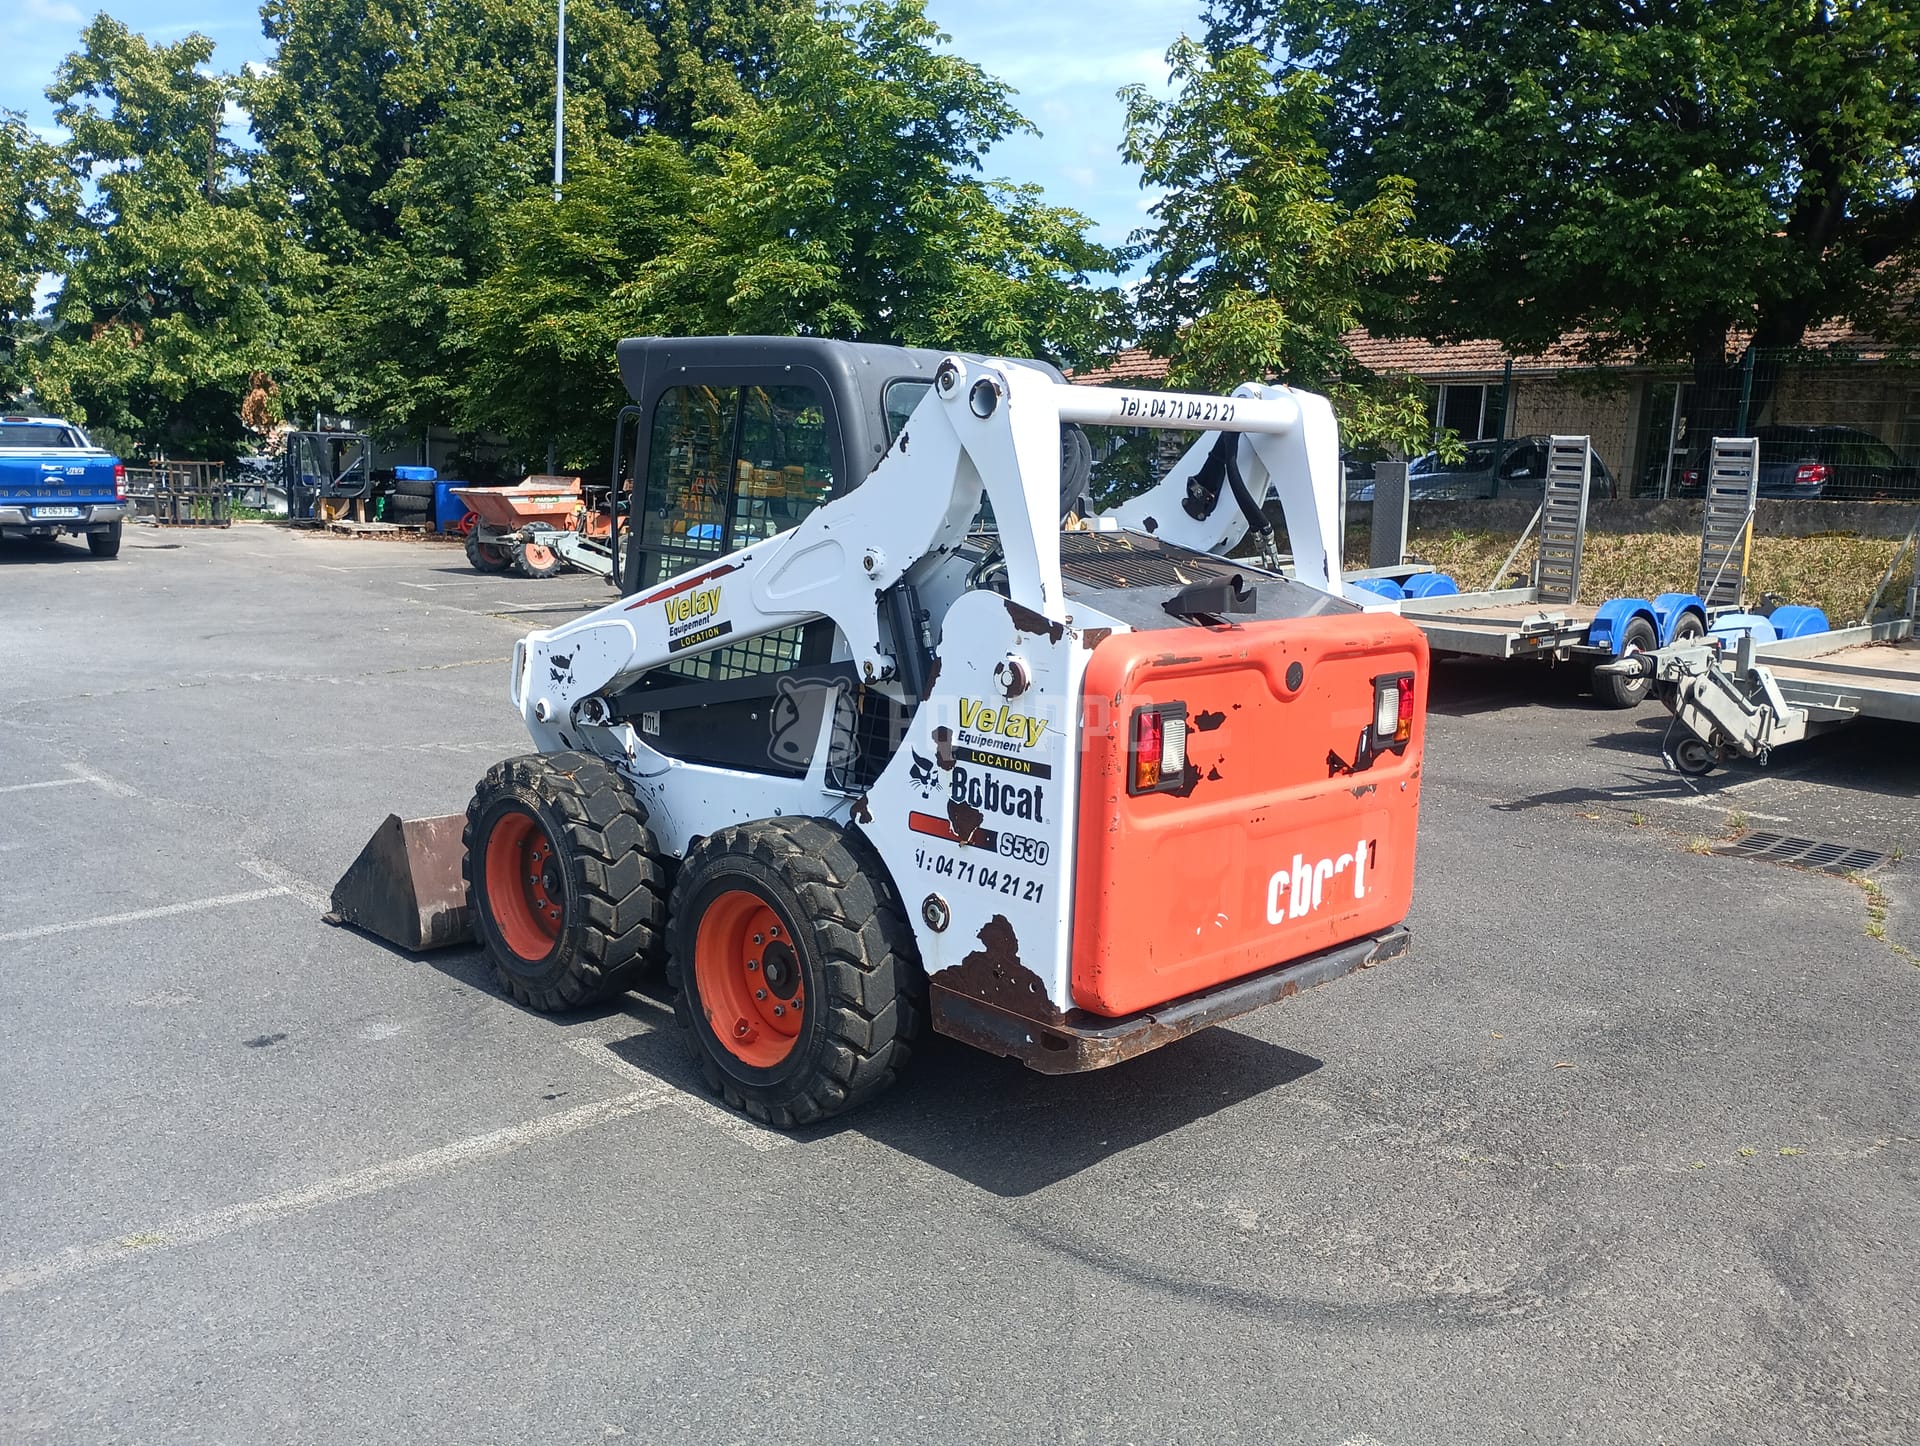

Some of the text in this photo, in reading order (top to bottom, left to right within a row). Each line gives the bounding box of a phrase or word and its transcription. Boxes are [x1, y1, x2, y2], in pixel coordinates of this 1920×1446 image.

[1150, 399, 1166, 418] 04
[1169, 400, 1183, 419] 71
[1187, 401, 1202, 419] 04
[1203, 402, 1218, 421] 21
[1220, 403, 1235, 421] 21
[665, 586, 721, 625] Velay
[669, 614, 710, 637] Equipement
[680, 627, 720, 647] LOCATION
[959, 697, 1049, 748] Velay
[958, 730, 1022, 753] Equipement
[972, 752, 1031, 773] LOCATION
[951, 766, 1044, 823] Bobcat
[1000, 832, 1050, 866] S530
[936, 855, 954, 876] 04
[957, 861, 975, 883] 71
[979, 867, 998, 890] 04
[1000, 874, 1021, 896] 21
[1023, 880, 1044, 903] 21
